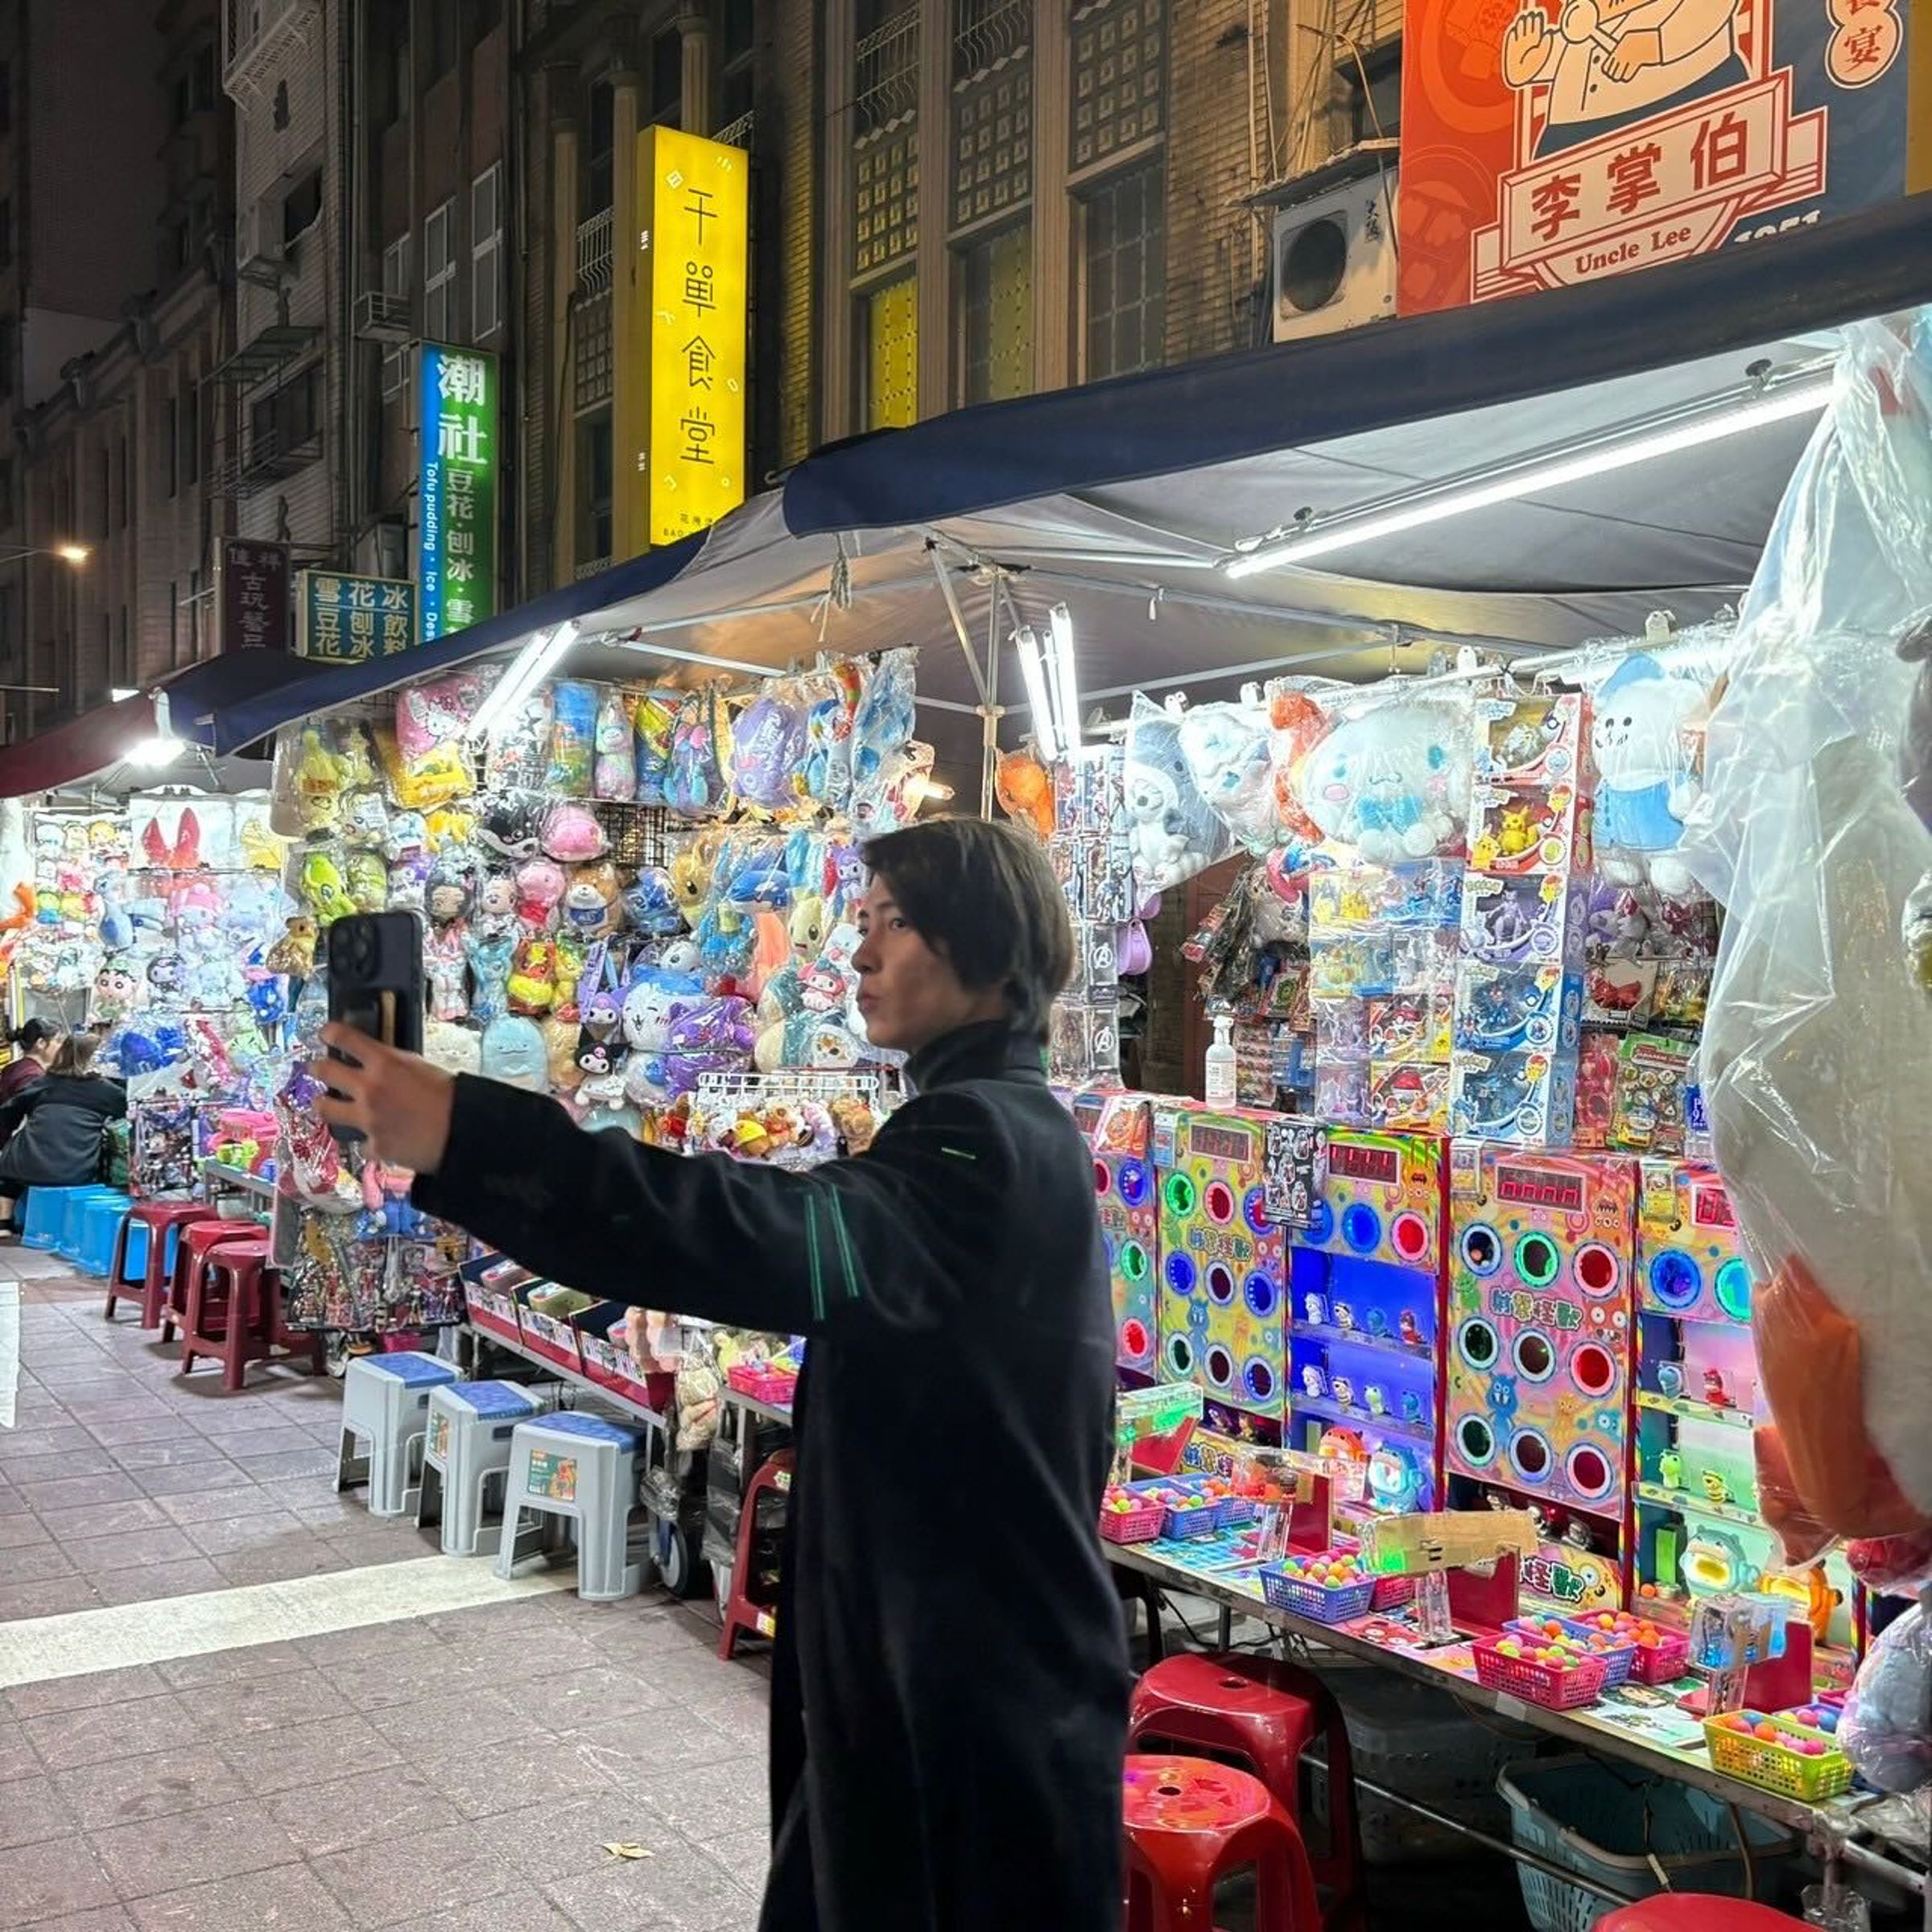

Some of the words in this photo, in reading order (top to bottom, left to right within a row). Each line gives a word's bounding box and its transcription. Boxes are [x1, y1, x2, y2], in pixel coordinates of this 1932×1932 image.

[1530, 112, 1748, 241] 李掌伯
[1575, 242, 1640, 275] Uncle
[1651, 225, 1691, 252] Lee
[436, 354, 488, 464] 潮社
[426, 462, 439, 492] Tofu
[423, 493, 439, 551] pudding
[315, 578, 408, 610] 雪花冰
[425, 571, 438, 592] Ice
